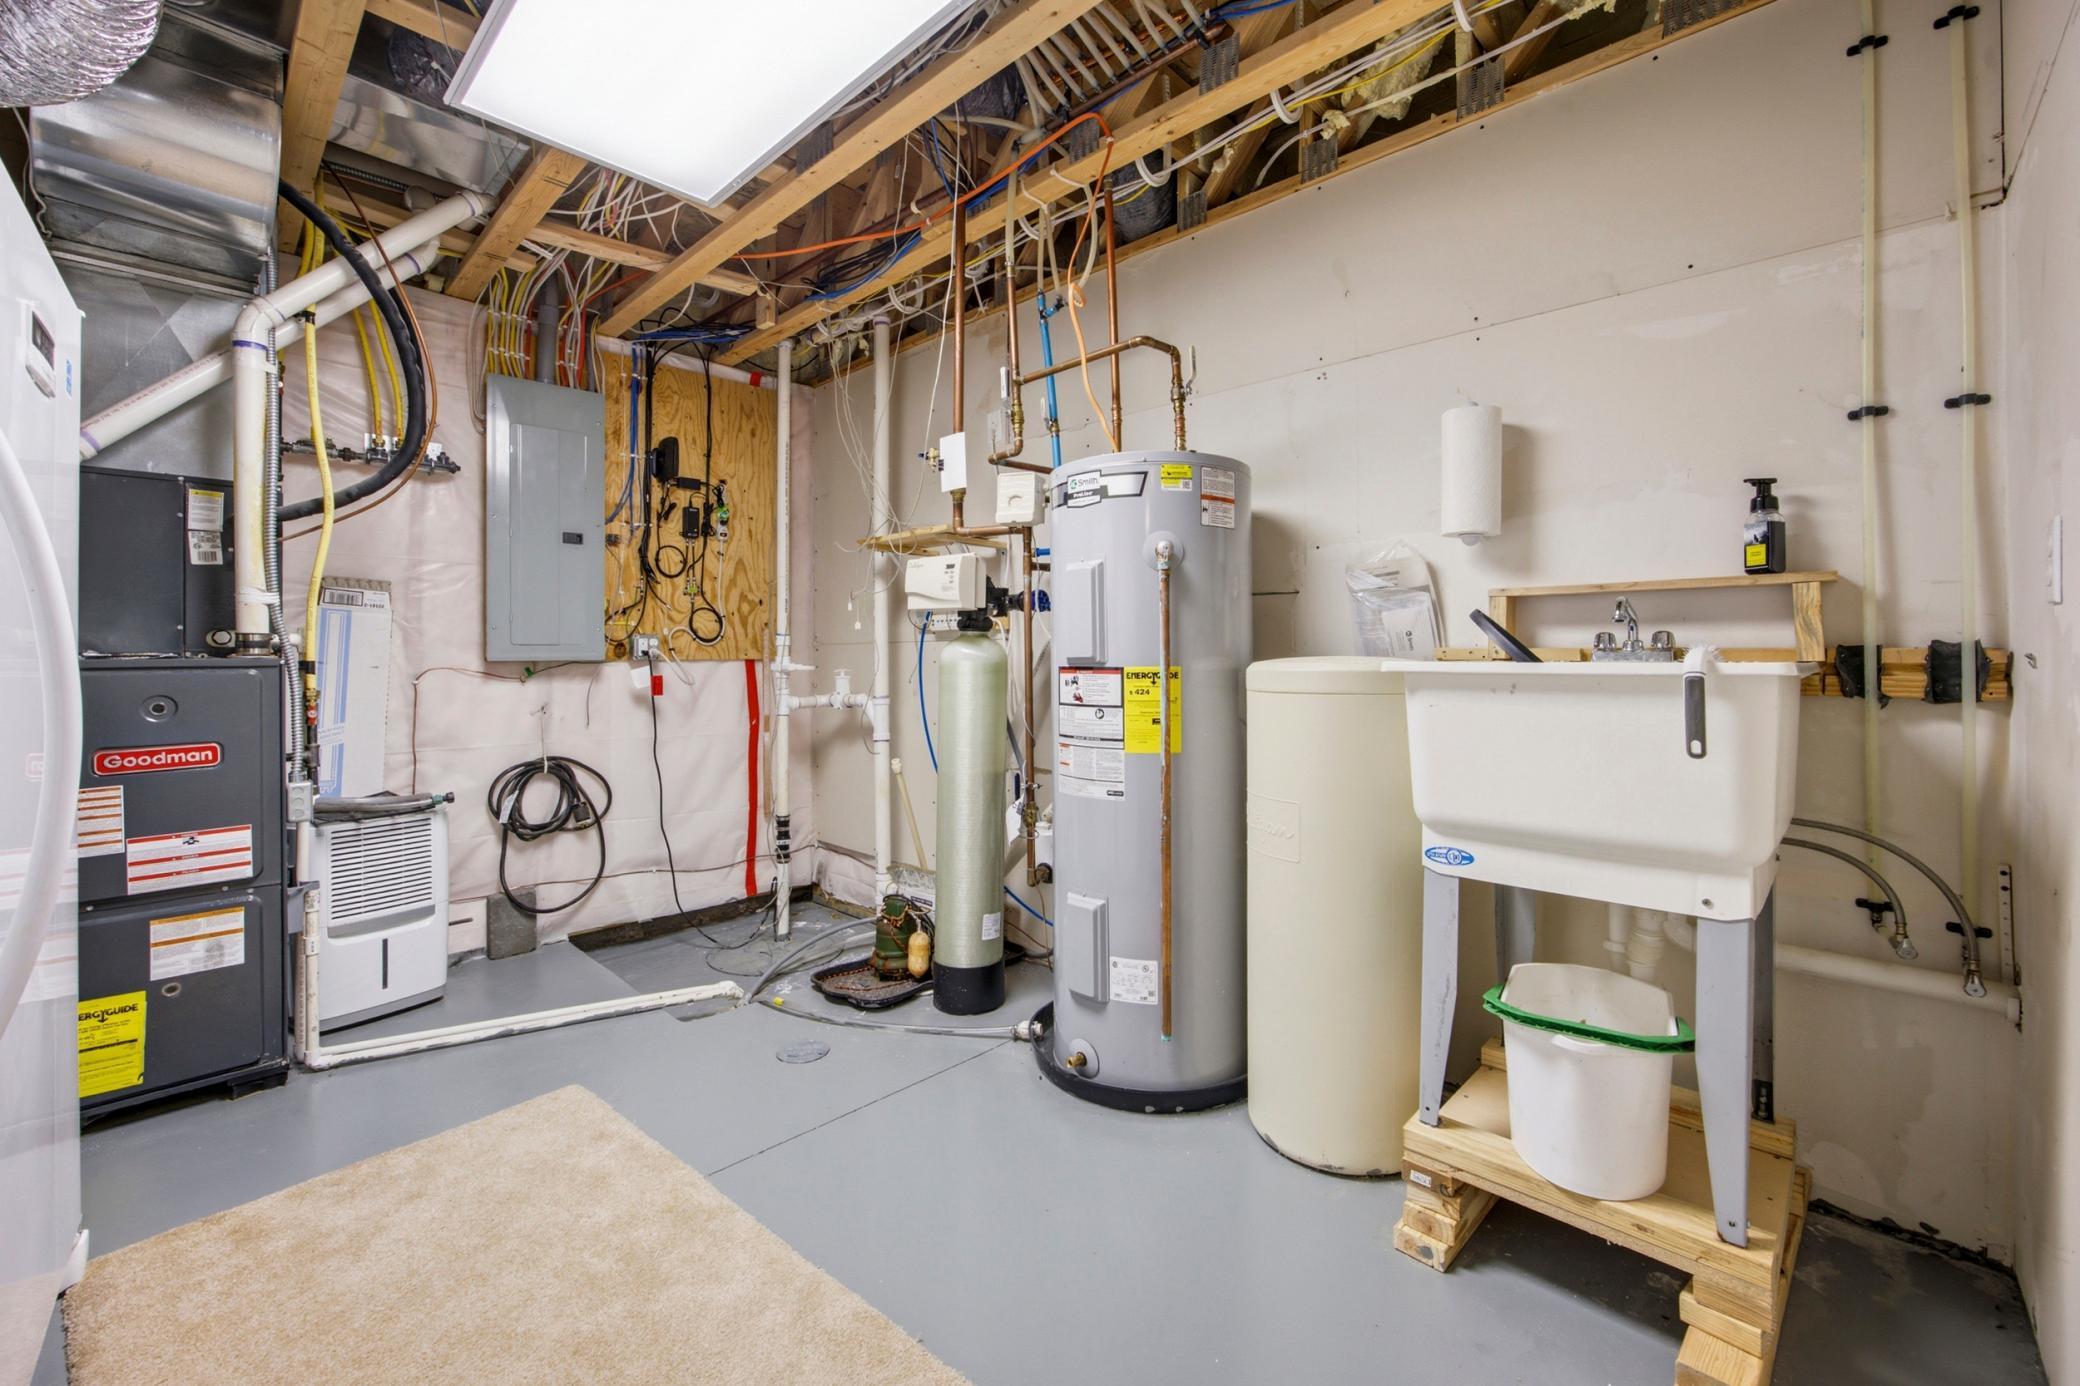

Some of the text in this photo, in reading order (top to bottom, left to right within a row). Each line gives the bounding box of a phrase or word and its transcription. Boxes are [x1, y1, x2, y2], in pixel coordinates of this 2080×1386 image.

[1126, 671, 1179, 680] ENERGYGDE
[103, 750, 213, 768] Goodman
[79, 1003, 138, 1021] ERGYGUIDE
